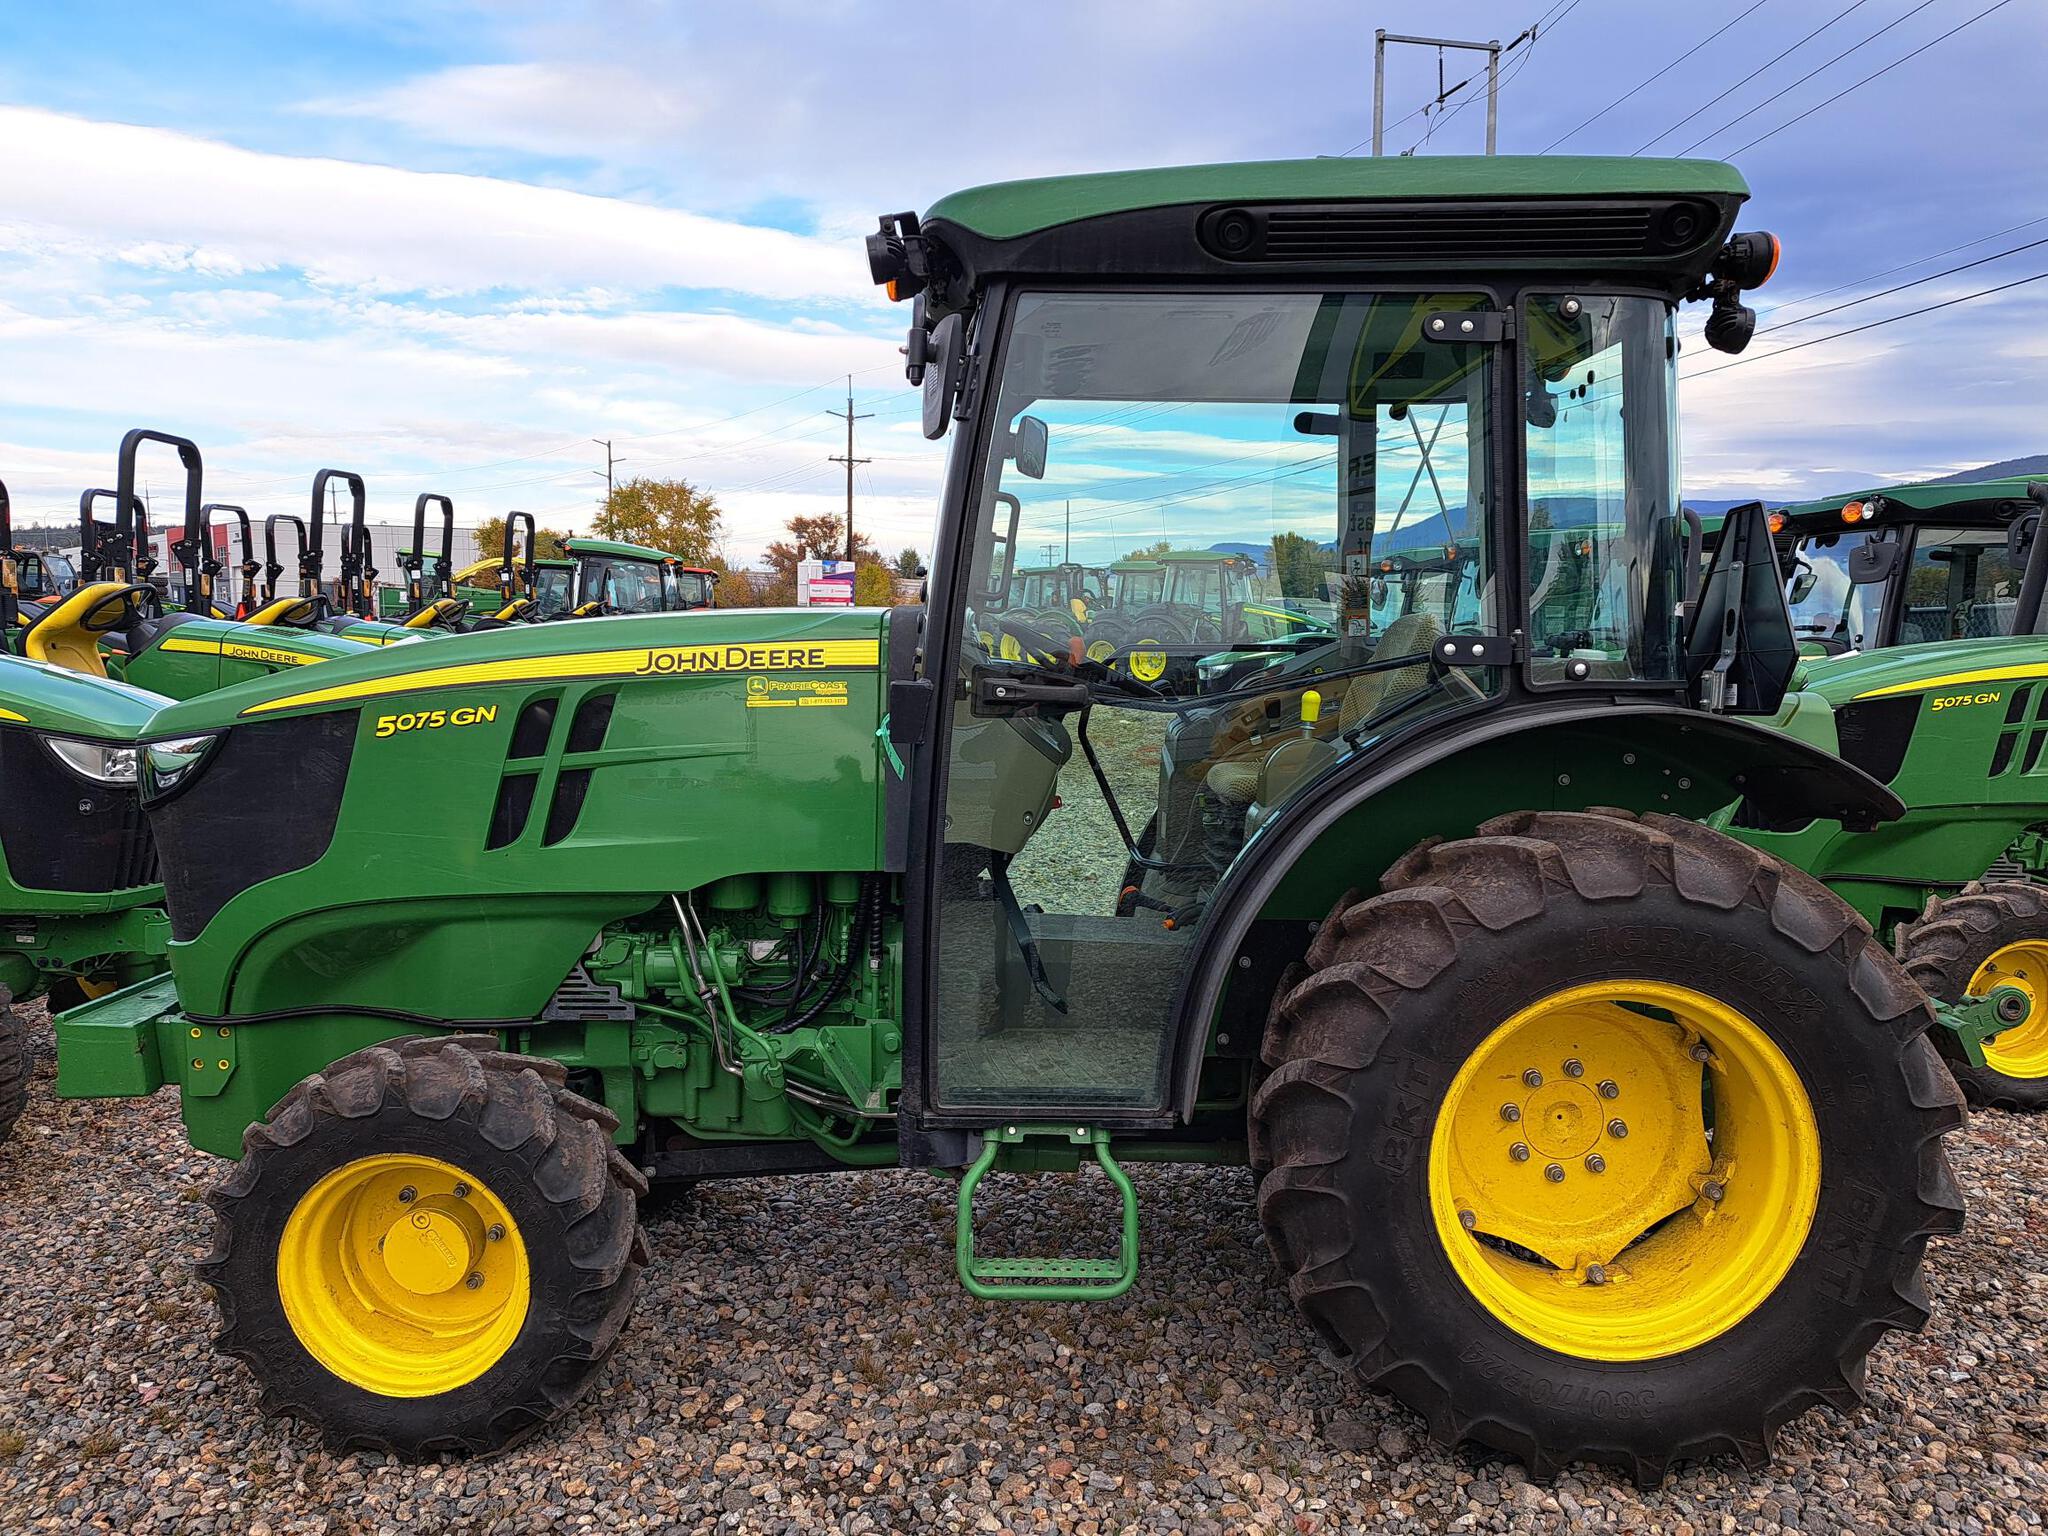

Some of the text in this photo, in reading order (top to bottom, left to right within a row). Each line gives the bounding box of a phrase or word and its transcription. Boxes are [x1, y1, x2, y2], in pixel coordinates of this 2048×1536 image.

[229, 646, 298, 663] JOHN DEERE
[636, 646, 825, 673] JOHN DEERE
[1931, 691, 2001, 711] 5075 GN
[375, 704, 498, 738] 5075 GN
